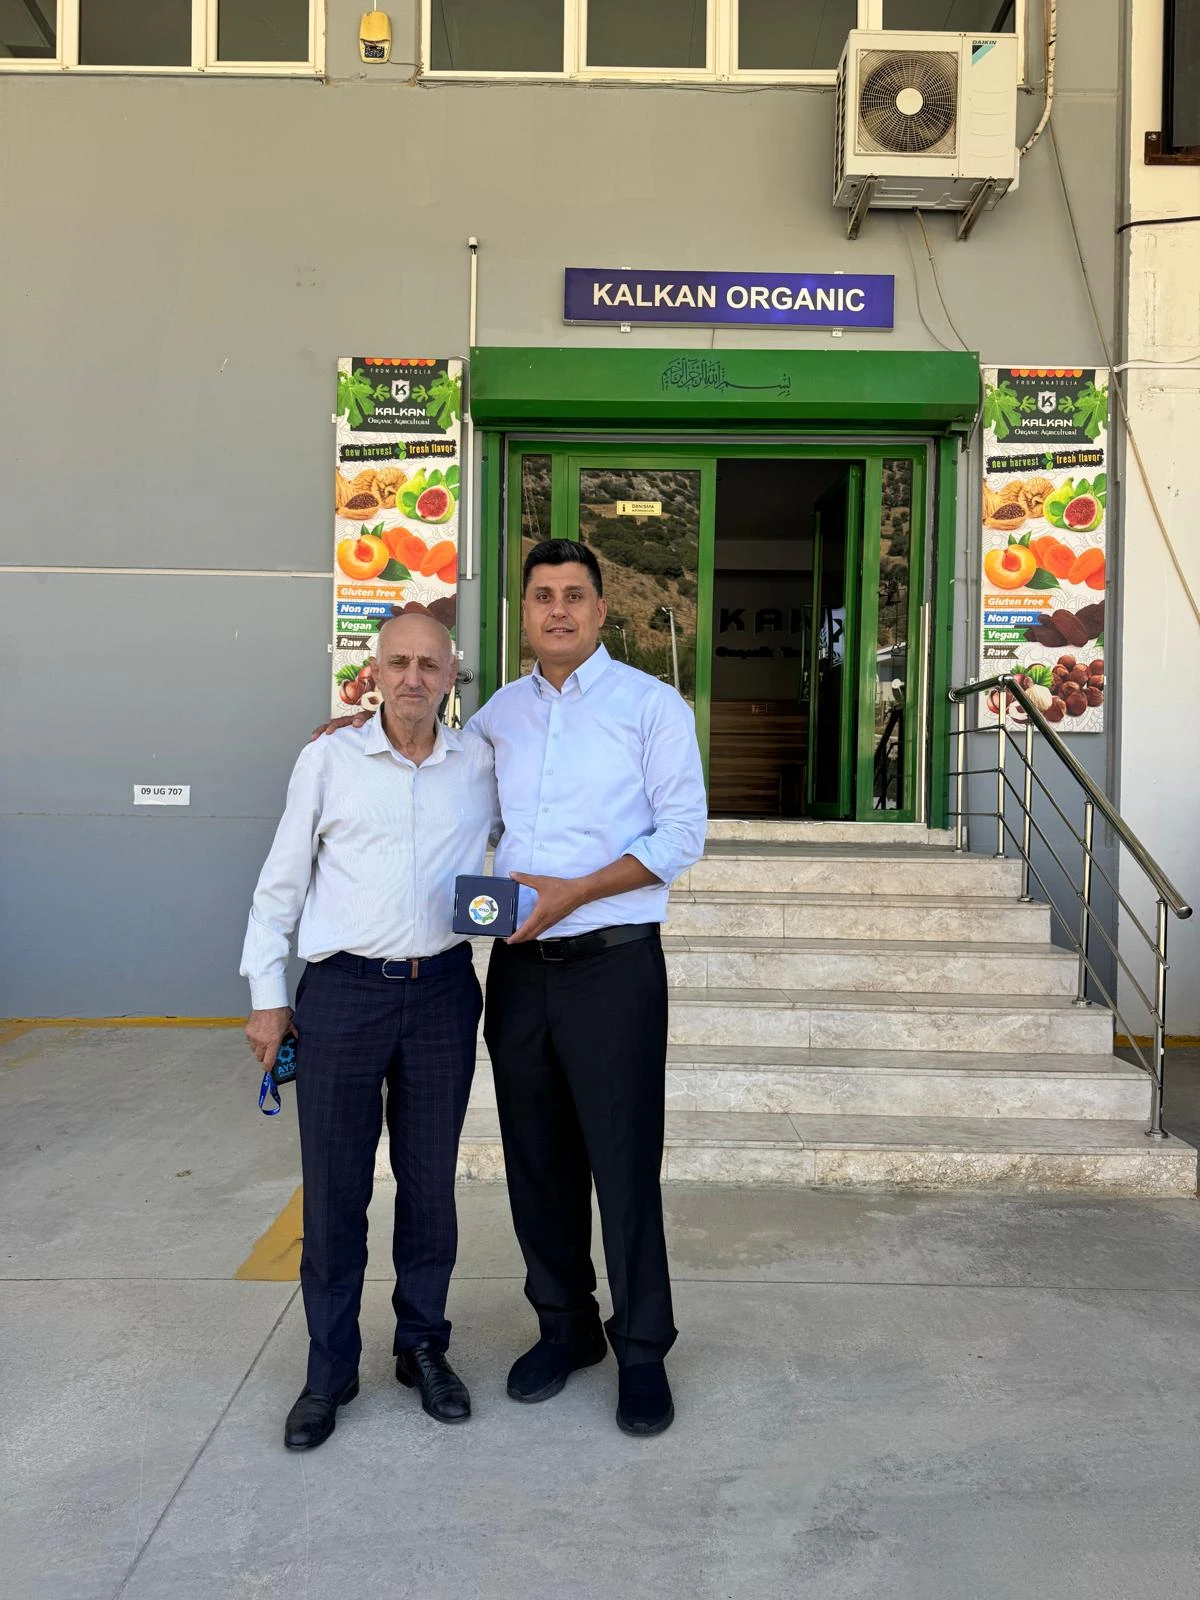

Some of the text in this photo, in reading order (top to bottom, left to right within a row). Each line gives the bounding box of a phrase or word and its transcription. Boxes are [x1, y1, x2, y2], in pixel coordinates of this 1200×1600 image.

[593, 283, 865, 312] KALKAN ORGANIC
[375, 407, 426, 417] KALKAN
[1022, 418, 1073, 428] KALKAN
[345, 444, 453, 457] new harvest fresh flavor
[992, 454, 1100, 468] new harvest fresh flavor
[341, 588, 397, 597] Gluten free
[988, 598, 1044, 606] Gluten free
[340, 604, 386, 615] Non gmo
[987, 614, 1034, 624] Non gmo
[341, 622, 372, 631] Vegan
[988, 631, 1020, 640] Vegan
[340, 638, 362, 647] Raw
[987, 648, 1010, 656] Raw
[140, 787, 182, 796] 09 UG 707
